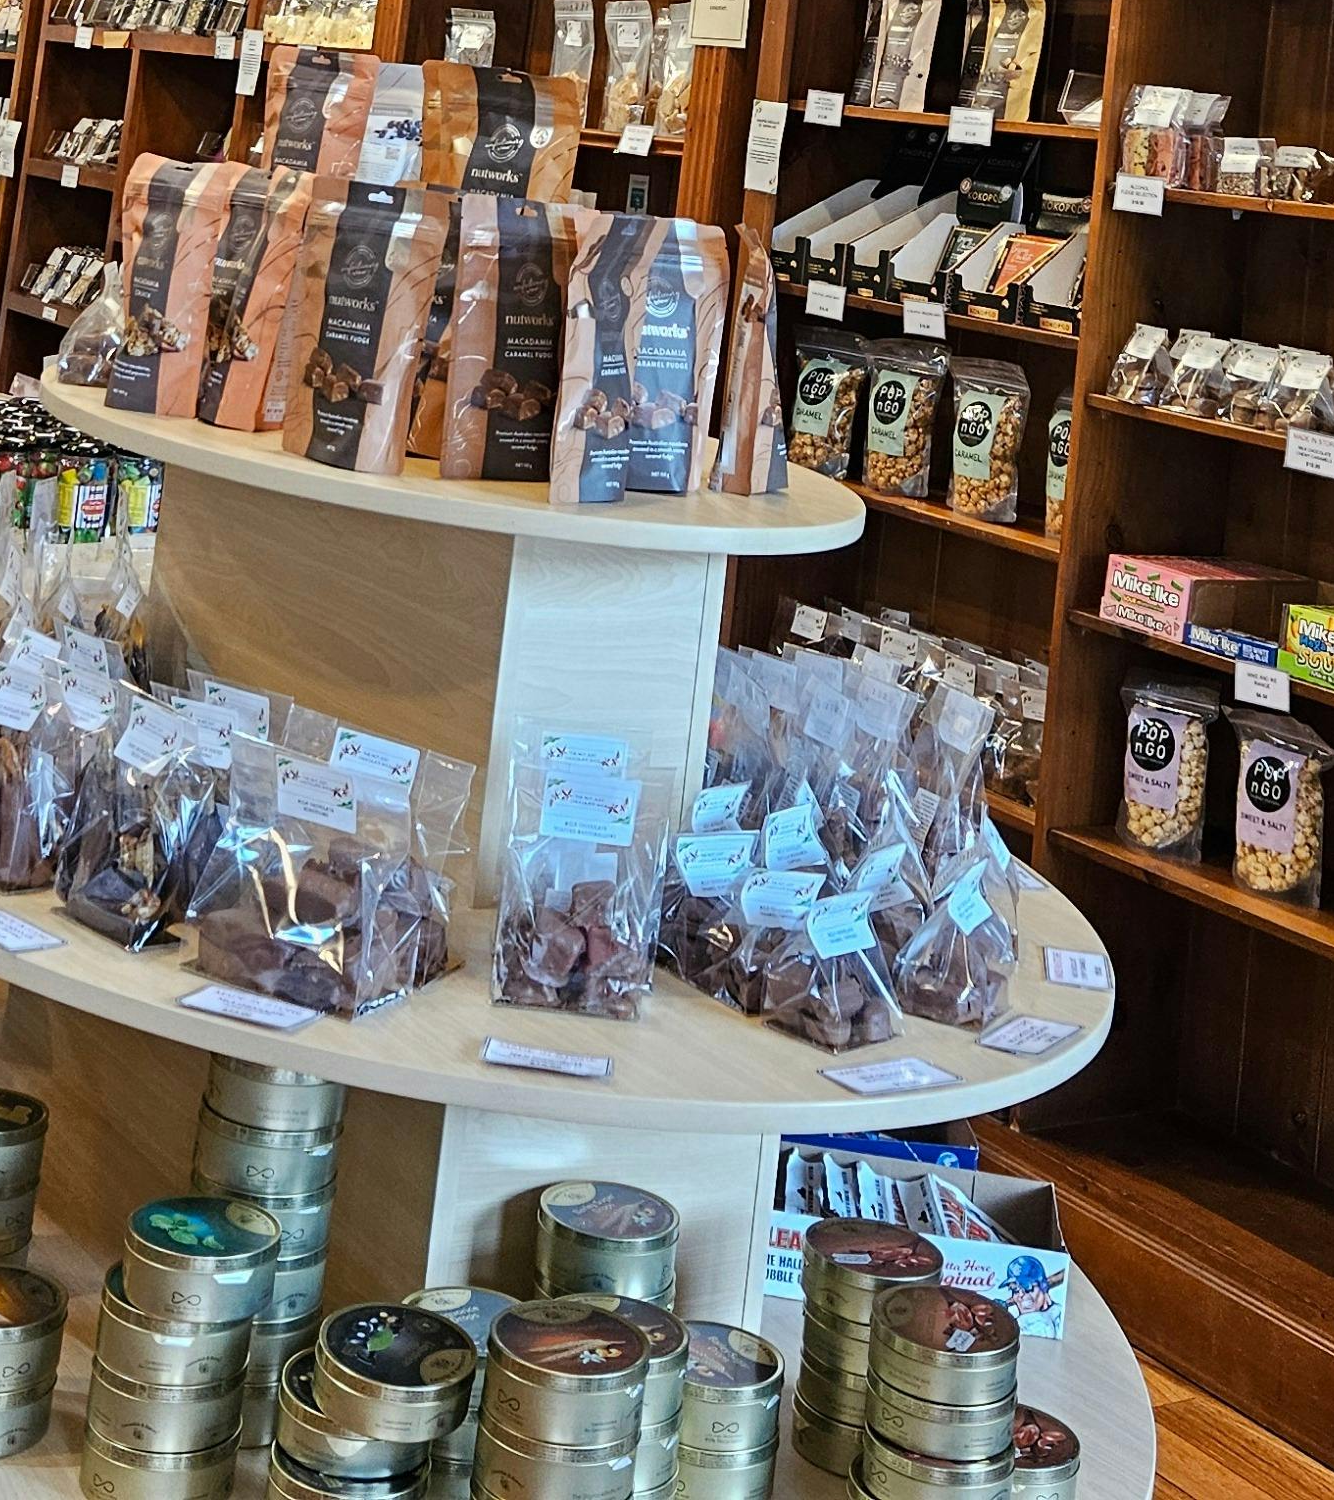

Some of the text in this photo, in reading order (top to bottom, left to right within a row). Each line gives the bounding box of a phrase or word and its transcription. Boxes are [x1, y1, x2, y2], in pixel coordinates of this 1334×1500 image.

[470, 166, 520, 184] nutworks
[329, 295, 376, 312] nutworks
[328, 317, 371, 331] MACADAMIA
[505, 313, 554, 327] nutworks
[325, 331, 370, 345] CARAMEL FUDGE
[507, 336, 554, 347] MACADAMIA
[504, 350, 534, 359] CARAMEL
[666, 361, 689, 371] FUDGE
[807, 371, 832, 384] POP
[879, 384, 903, 401] POP
[871, 427, 897, 441] CARAMEL
[954, 448, 983, 464] CARAMEL
[1112, 570, 1180, 608] Mike Ike
[1117, 605, 1164, 631] Mike Ike
[1190, 624, 1220, 646] Mike
[1221, 636, 1239, 655] Ike
[1137, 720, 1170, 743] POP
[1151, 778, 1171, 790] SALTY
[1267, 819, 1287, 833] SALTY
[964, 1258, 991, 1272] Here
